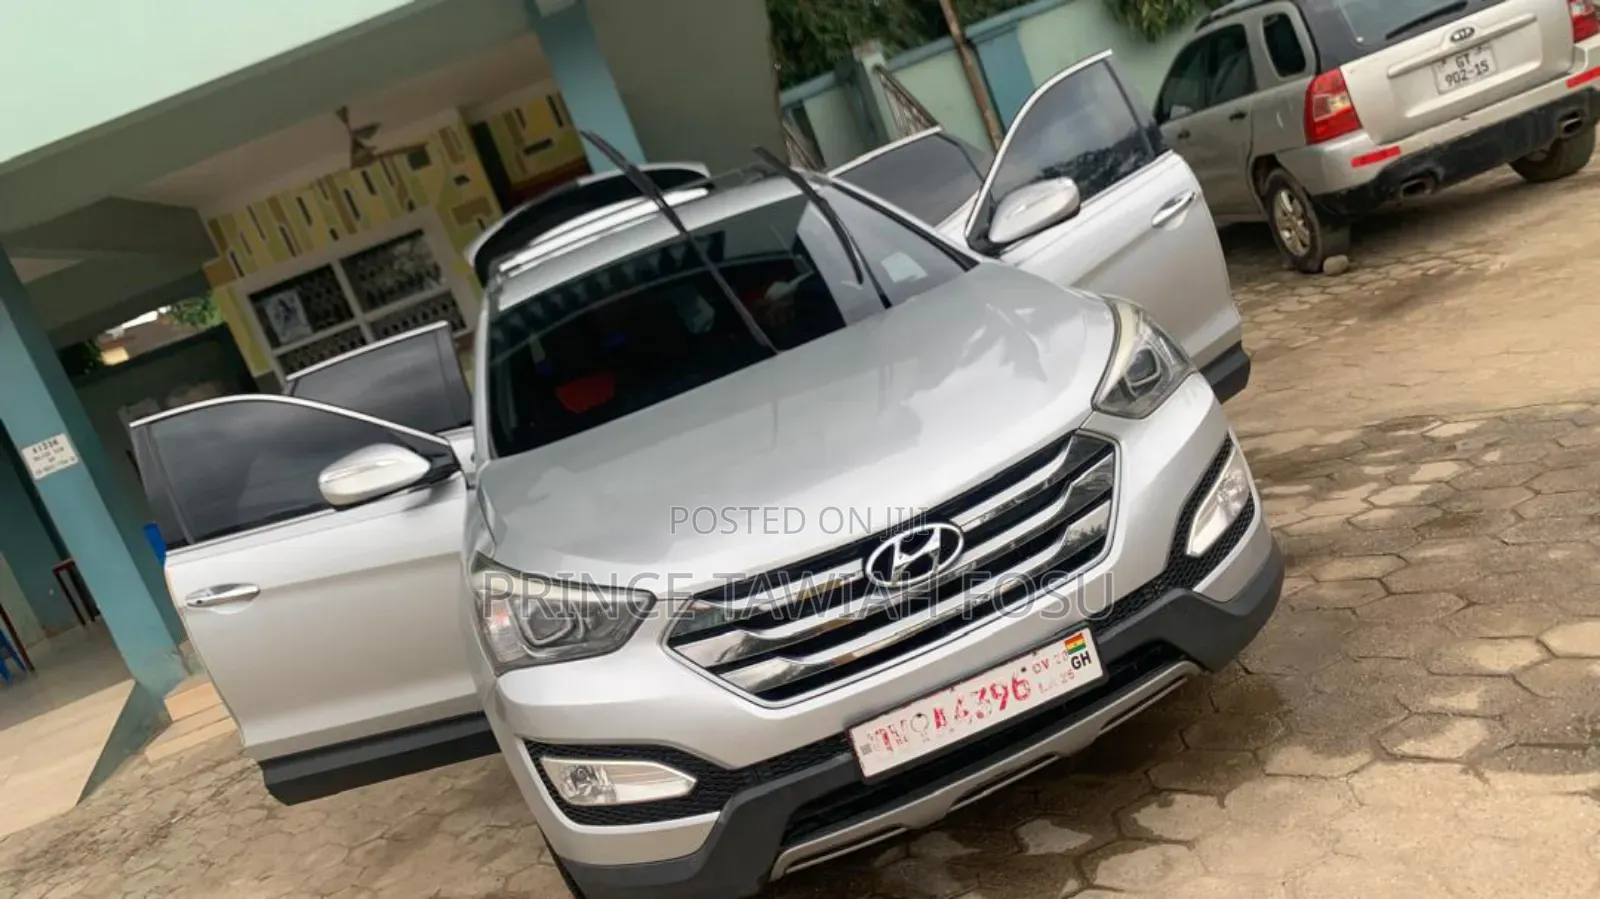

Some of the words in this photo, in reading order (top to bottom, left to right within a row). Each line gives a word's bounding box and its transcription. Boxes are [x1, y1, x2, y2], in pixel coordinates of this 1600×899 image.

[1455, 53, 1470, 69] GT
[1445, 60, 1490, 87] 902-15
[1071, 651, 1092, 671] GH
